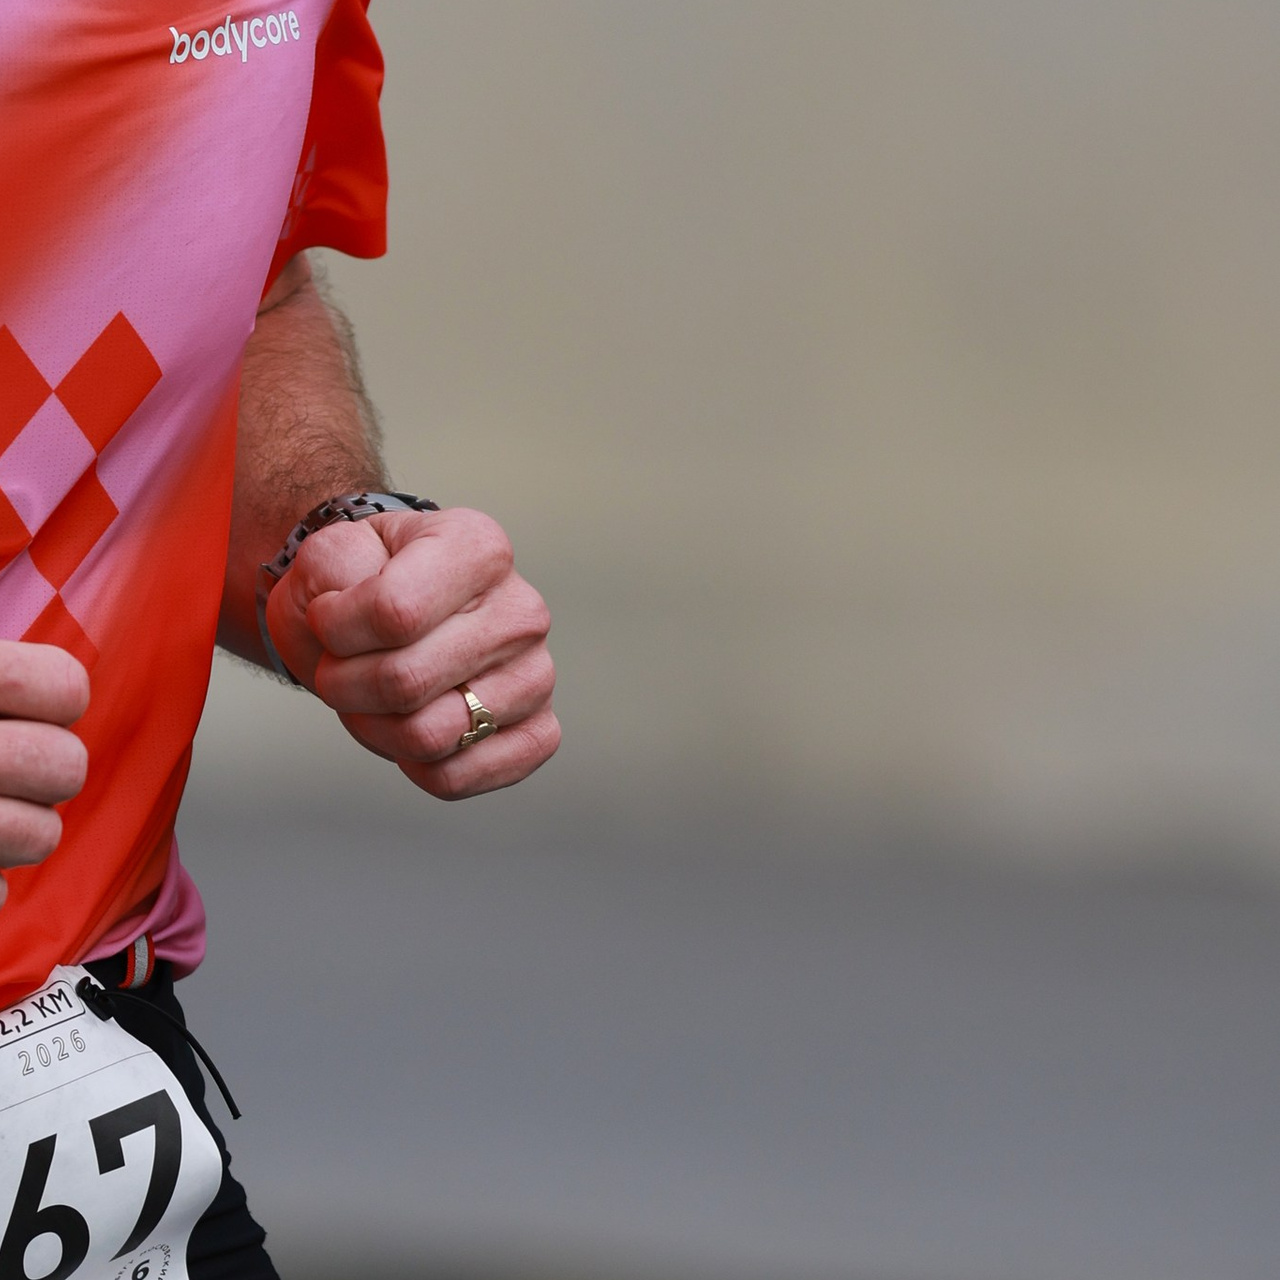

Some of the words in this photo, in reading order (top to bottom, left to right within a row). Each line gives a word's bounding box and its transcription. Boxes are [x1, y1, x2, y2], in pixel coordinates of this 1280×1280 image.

[169, 10, 300, 64] bodycore
[32, 987, 74, 1019] КМ
[18, 1029, 87, 1077] 2026
